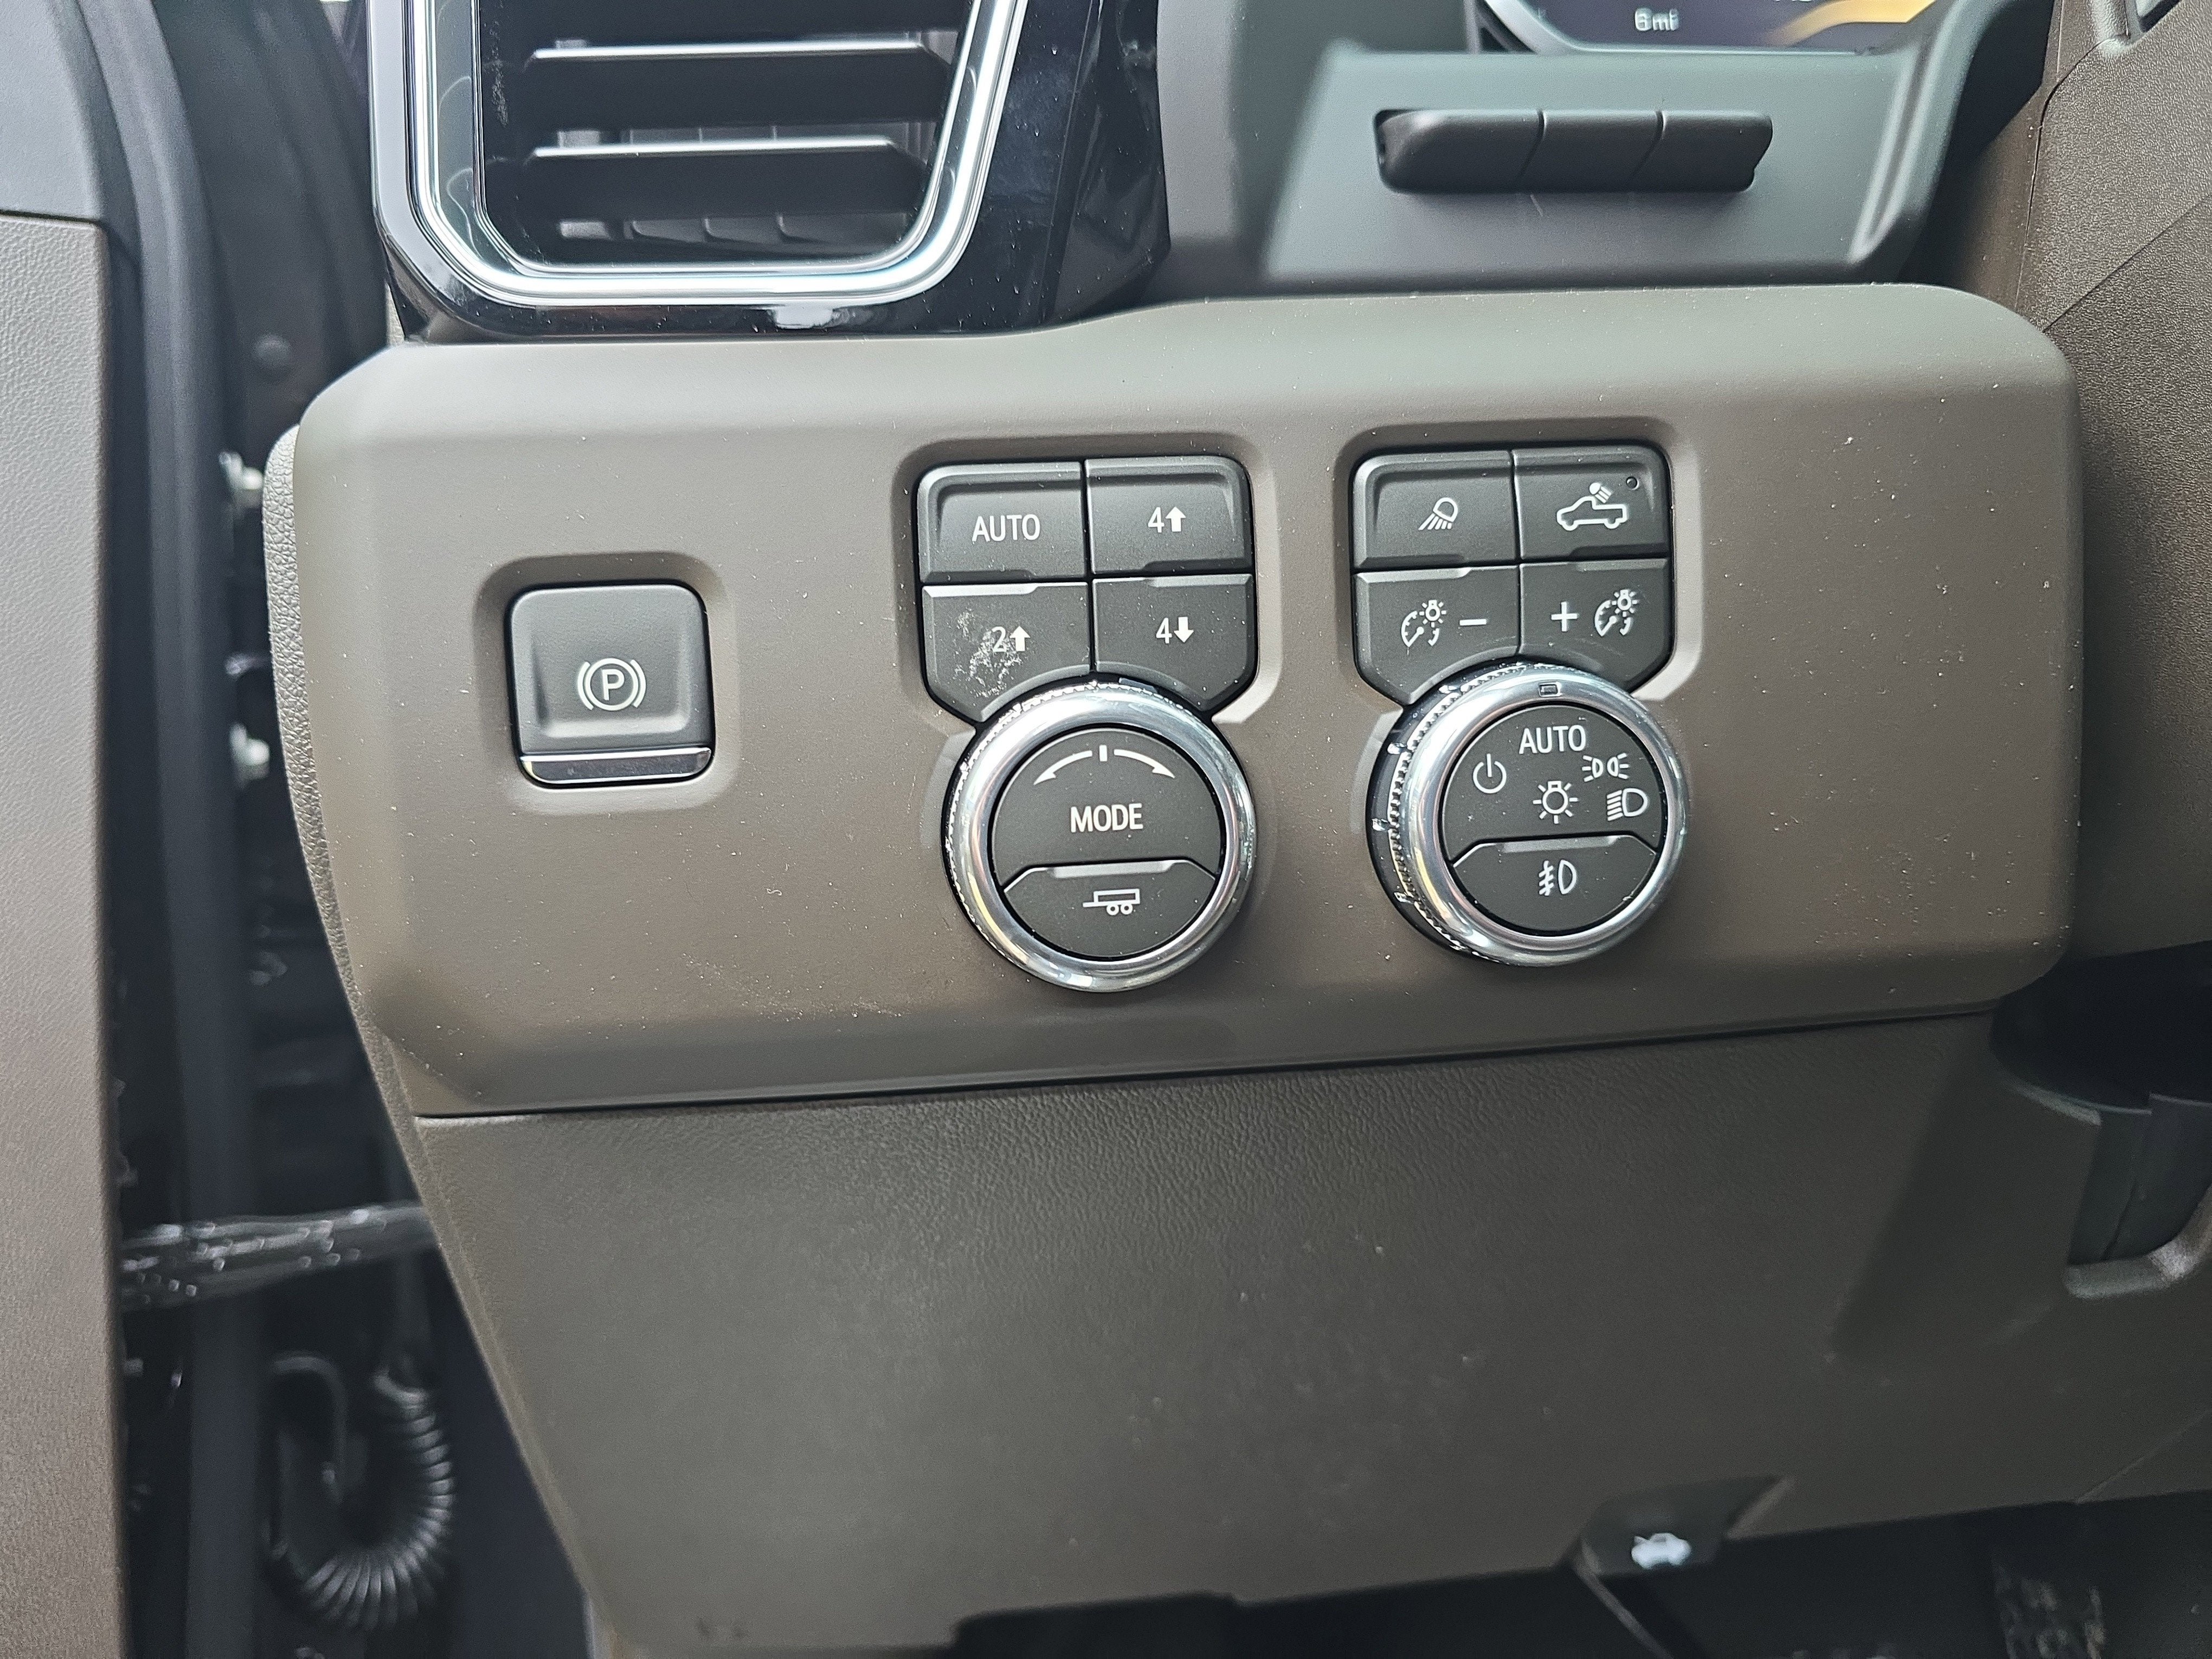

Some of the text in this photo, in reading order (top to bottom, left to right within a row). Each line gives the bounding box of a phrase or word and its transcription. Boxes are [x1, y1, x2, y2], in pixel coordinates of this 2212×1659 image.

[972, 513, 1040, 542] AUTO
[1519, 724, 1586, 754] AUTO
[1070, 803, 1144, 833] MODE
